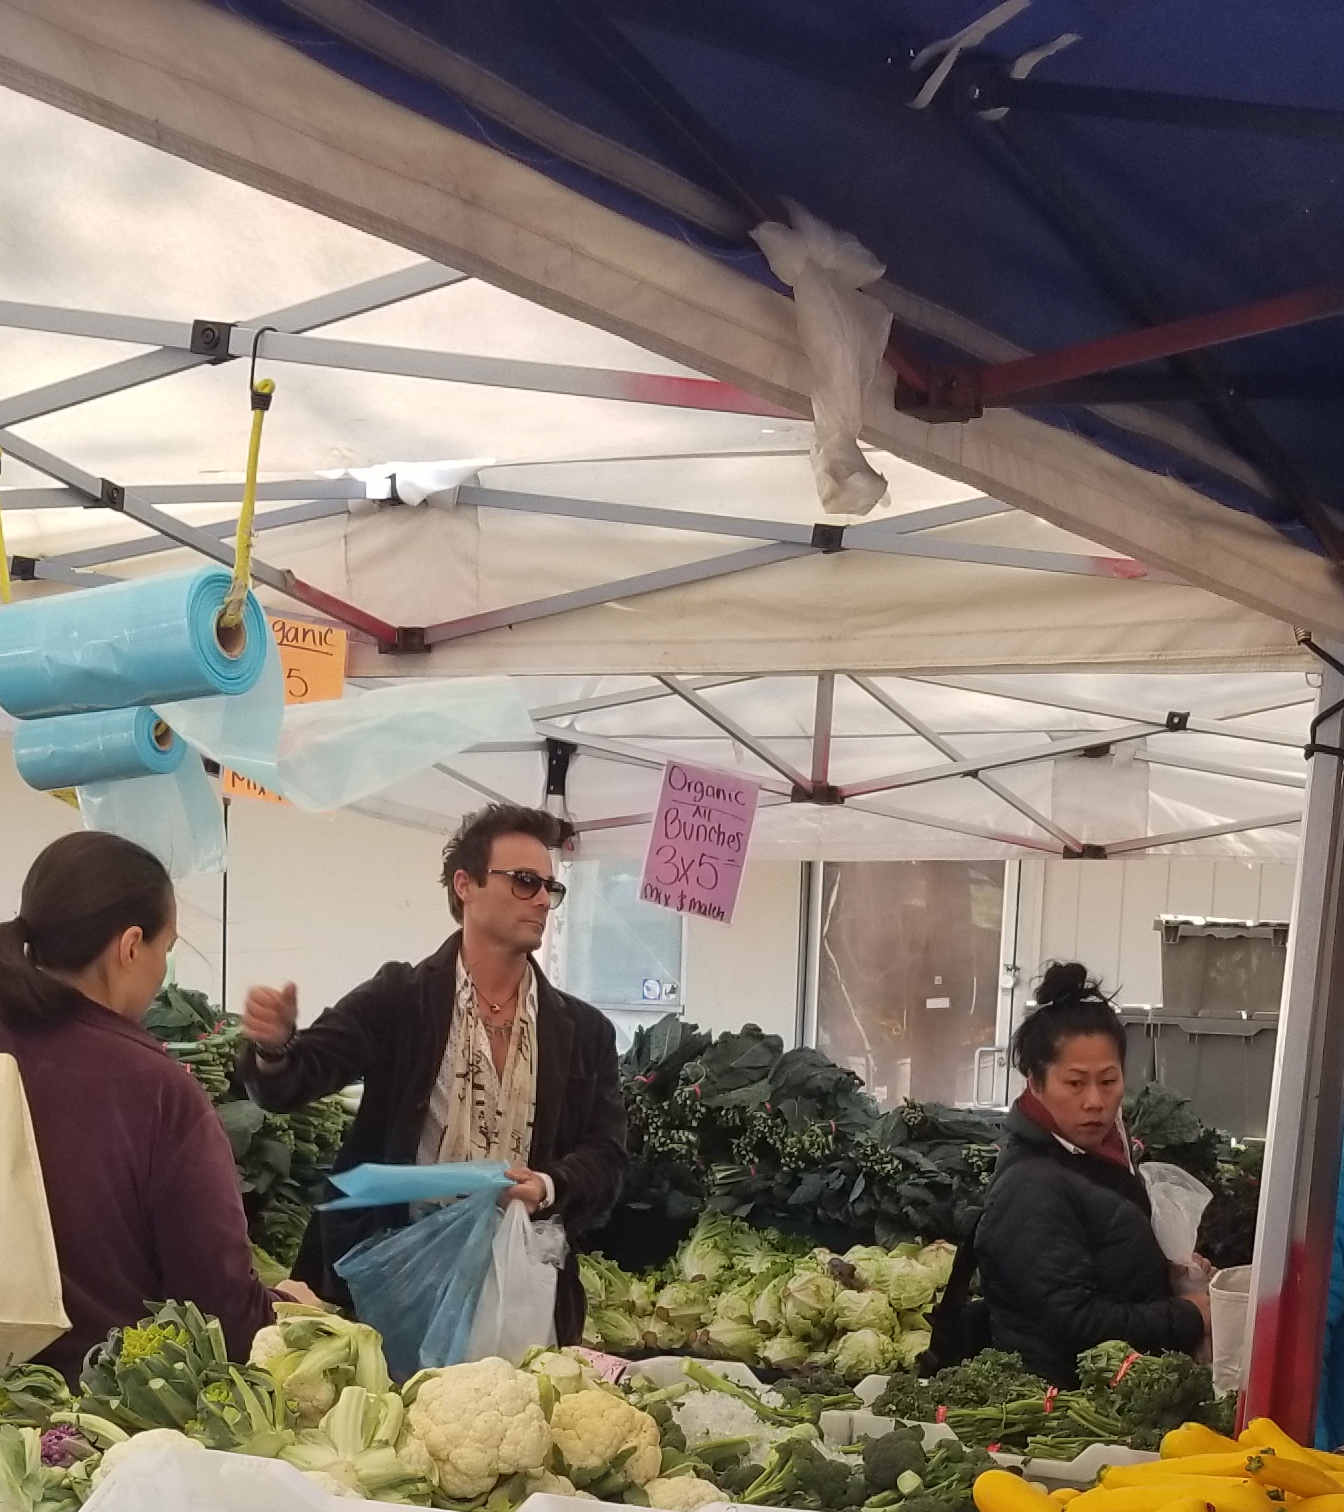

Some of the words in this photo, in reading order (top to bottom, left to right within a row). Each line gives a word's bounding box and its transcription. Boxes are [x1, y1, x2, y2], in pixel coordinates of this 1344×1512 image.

[272, 619, 336, 648] ganic
[668, 765, 746, 806] Organic
[664, 807, 744, 852] Bunches
[692, 805, 712, 822] All
